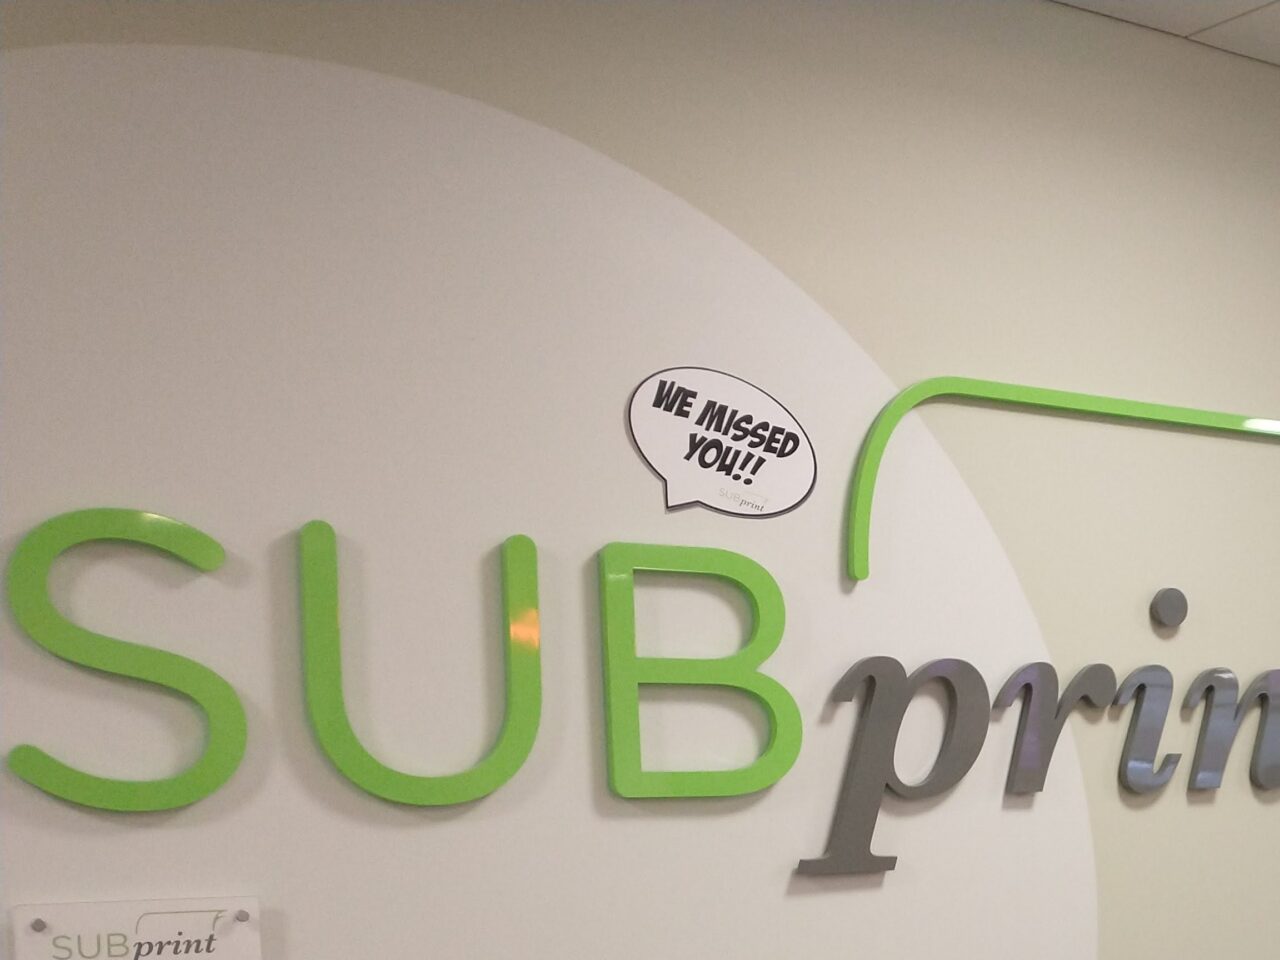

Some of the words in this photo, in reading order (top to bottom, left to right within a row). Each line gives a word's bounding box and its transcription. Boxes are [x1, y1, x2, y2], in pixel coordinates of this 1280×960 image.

[652, 379, 698, 419] WE
[694, 399, 800, 458] MISSED
[683, 432, 767, 486] YOU!!
